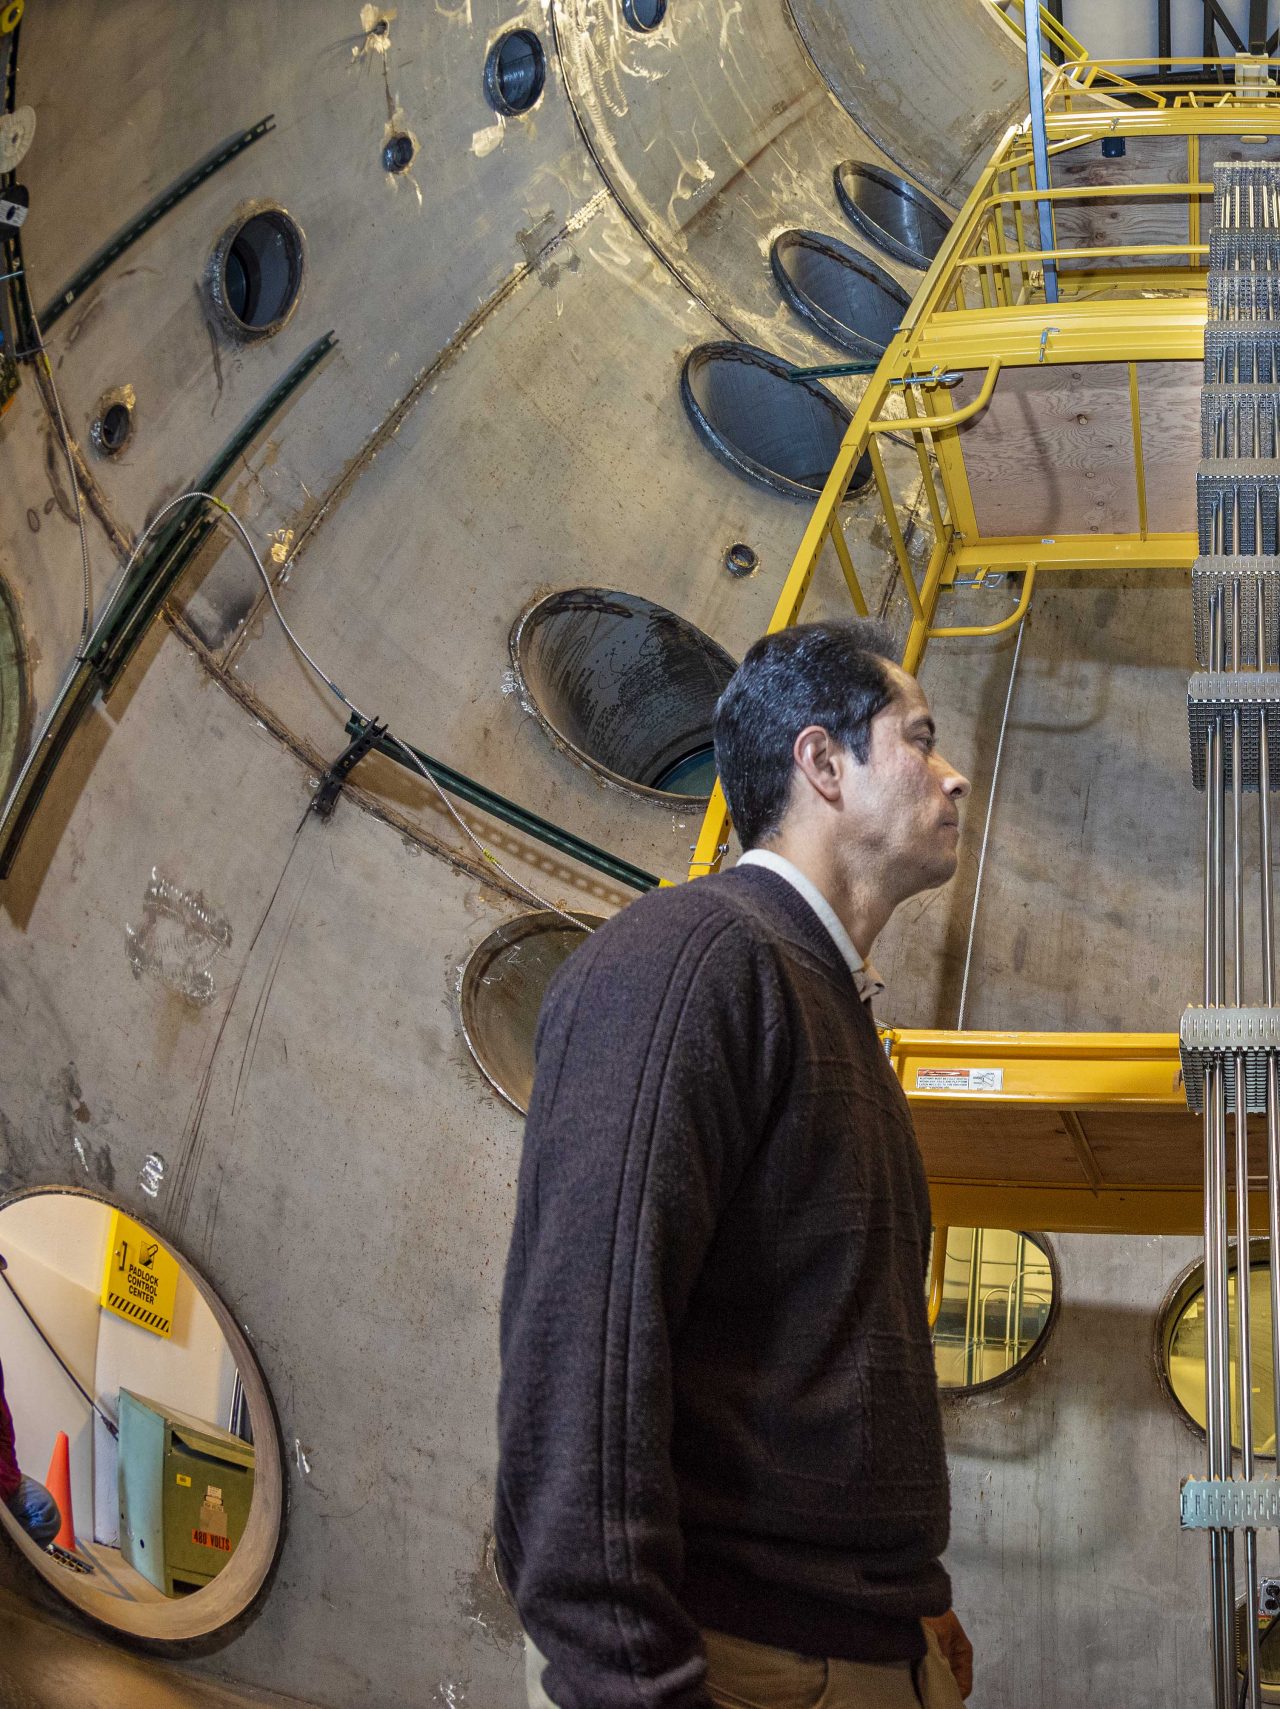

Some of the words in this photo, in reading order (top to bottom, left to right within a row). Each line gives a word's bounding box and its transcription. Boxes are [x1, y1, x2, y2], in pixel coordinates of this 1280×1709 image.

[128, 1274, 157, 1296] CONTROL
[129, 1264, 158, 1287] PADLOCK
[129, 1285, 154, 1304] CENTER
[194, 1530, 207, 1545] 480
[210, 1534, 230, 1551] VOLTS
